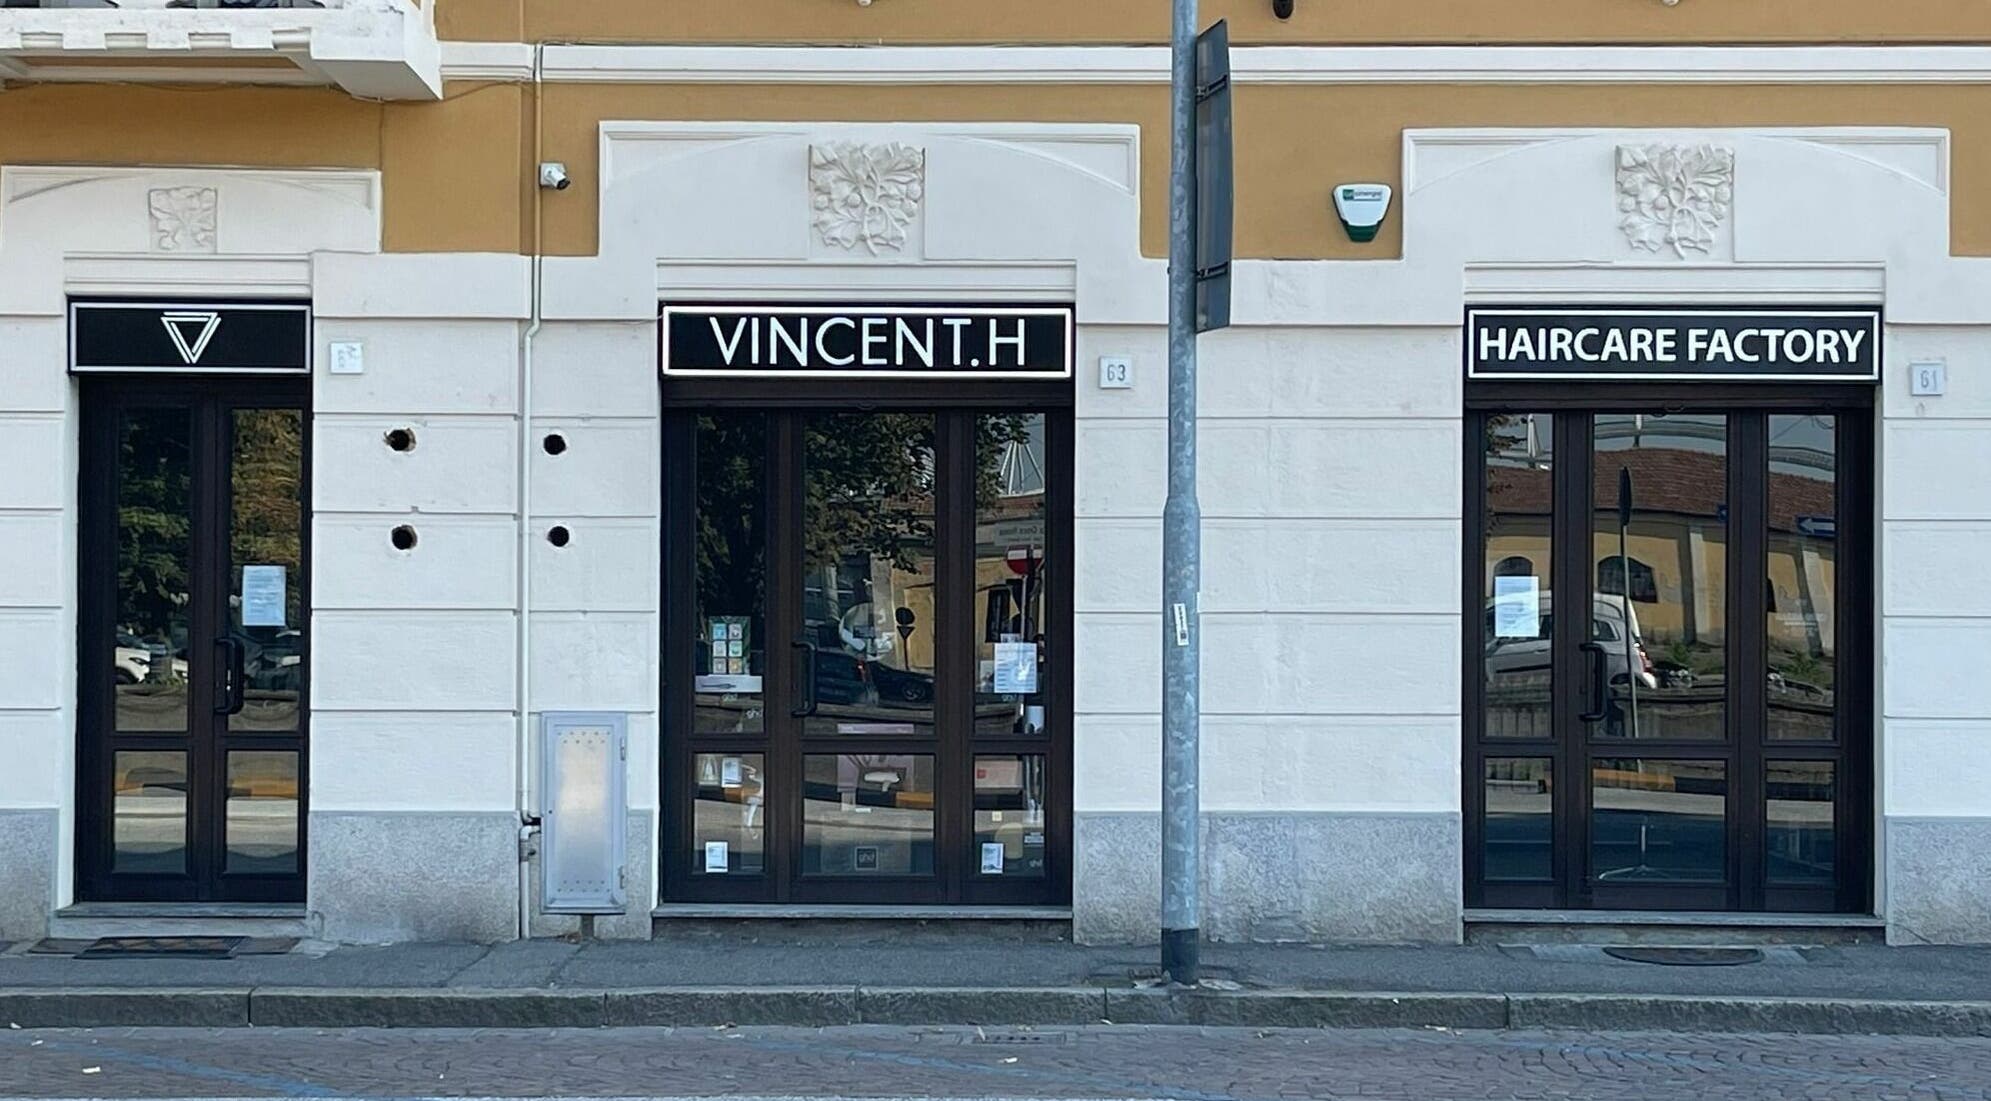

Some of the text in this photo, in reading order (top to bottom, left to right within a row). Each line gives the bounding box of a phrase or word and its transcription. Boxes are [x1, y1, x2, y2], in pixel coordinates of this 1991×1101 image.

[709, 316, 1025, 367] VINCENT.H
[1479, 327, 1866, 364] HAIRCARE FACTORY
[1107, 364, 1126, 382] 63
[1920, 370, 1938, 391] 61
